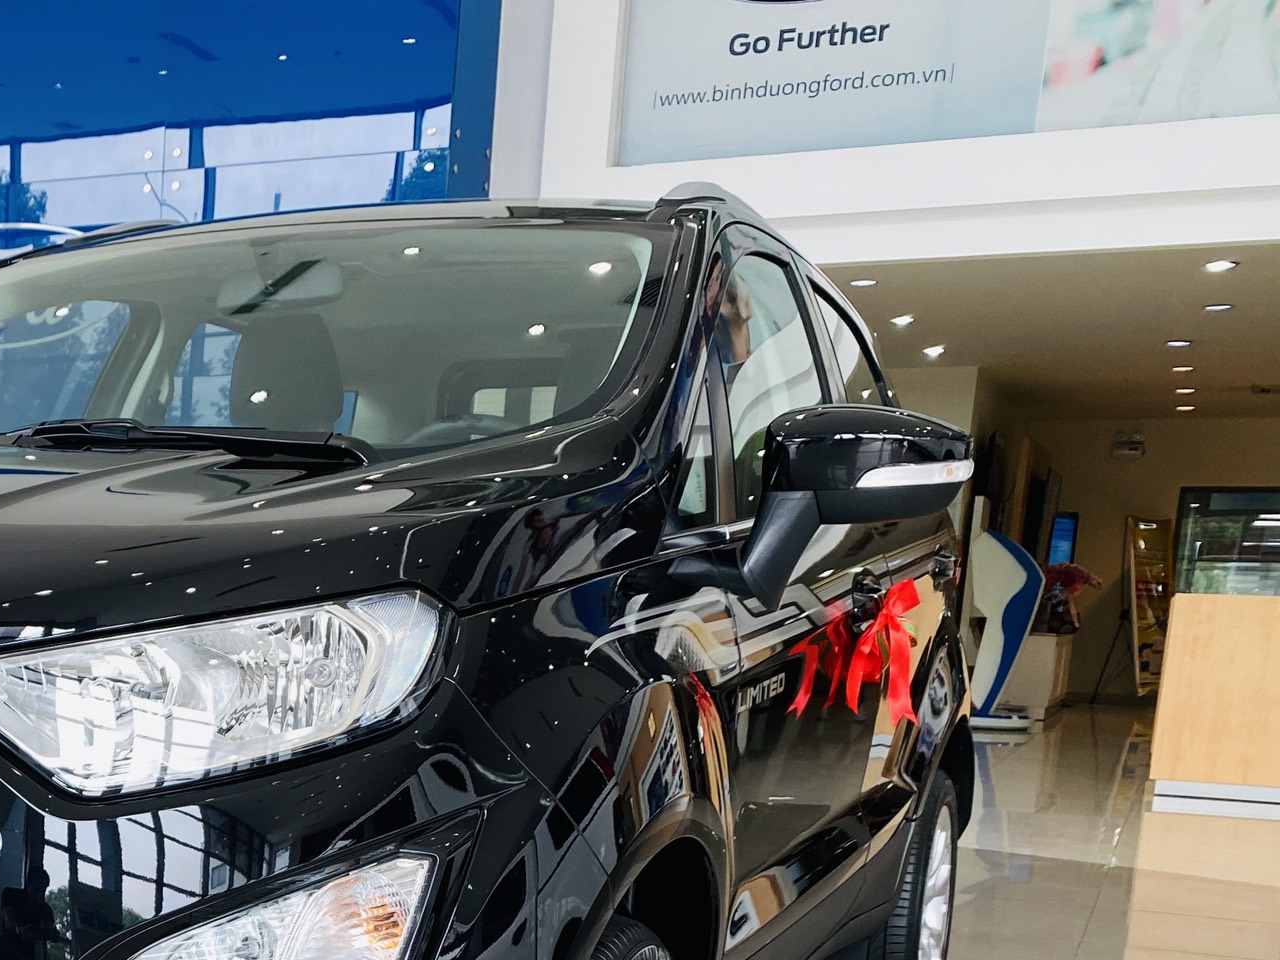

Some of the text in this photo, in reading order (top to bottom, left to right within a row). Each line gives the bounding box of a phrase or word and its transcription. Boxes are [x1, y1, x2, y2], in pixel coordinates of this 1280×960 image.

[729, 22, 891, 56] Go Further
[736, 672, 786, 713] LIMITED
